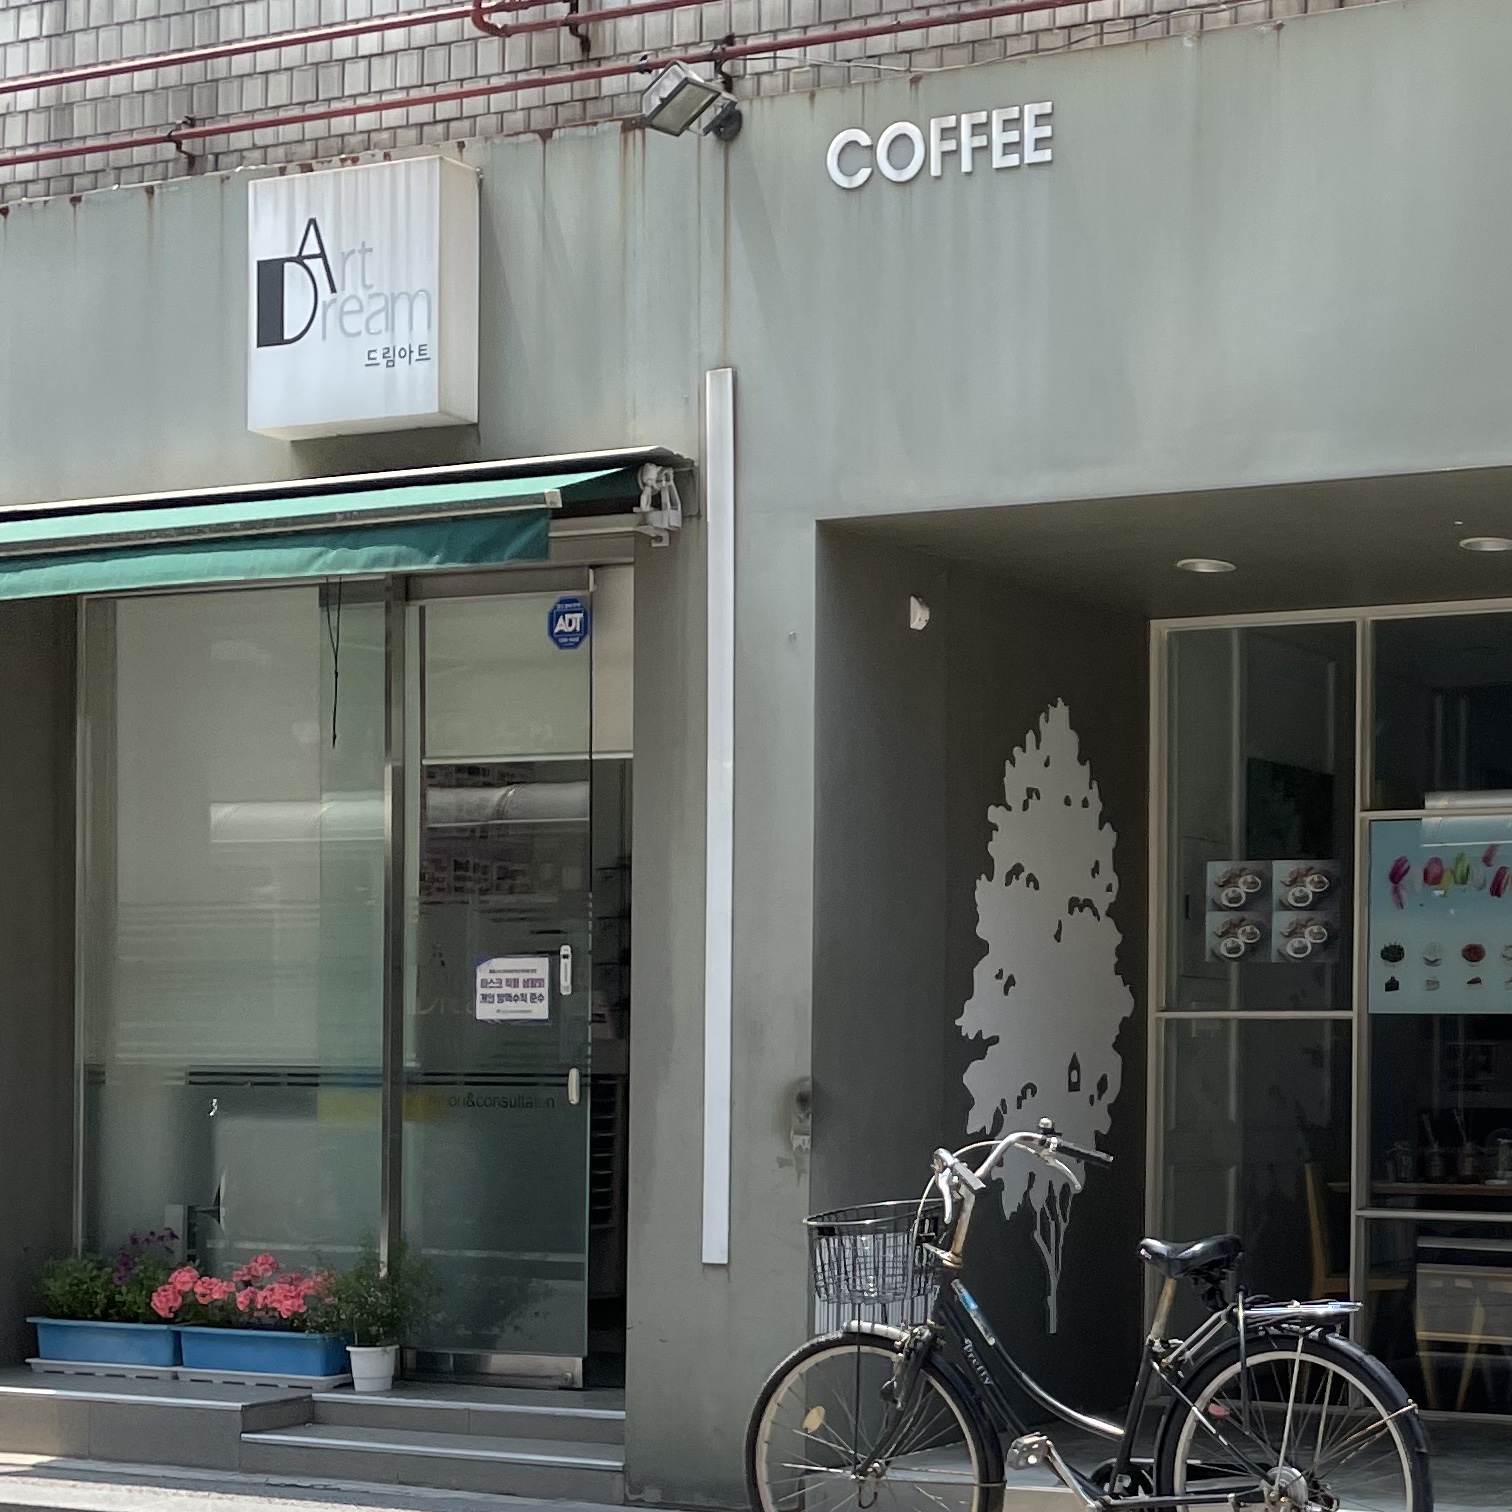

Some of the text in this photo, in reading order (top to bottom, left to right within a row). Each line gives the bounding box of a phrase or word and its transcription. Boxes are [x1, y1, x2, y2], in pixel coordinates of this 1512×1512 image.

[826, 101, 1053, 189] COFFEE
[298, 217, 374, 294] Art
[256, 256, 433, 349] Dream
[364, 343, 431, 368] 드림아트
[553, 612, 584, 633] ADT
